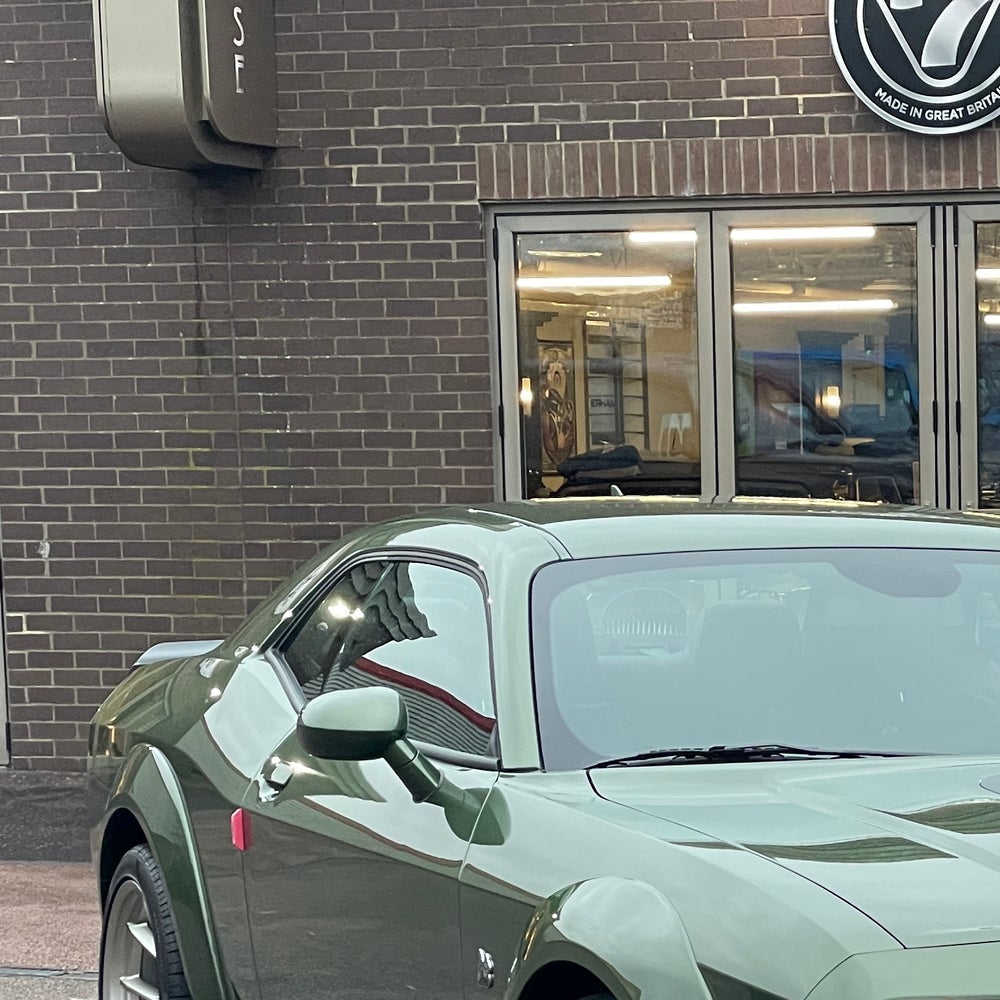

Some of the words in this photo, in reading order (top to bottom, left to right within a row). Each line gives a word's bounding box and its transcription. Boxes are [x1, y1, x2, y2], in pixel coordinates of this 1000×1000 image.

[875, 88, 906, 114] MADE
[909, 106, 922, 119] IN
[925, 108, 964, 121] GREAT
